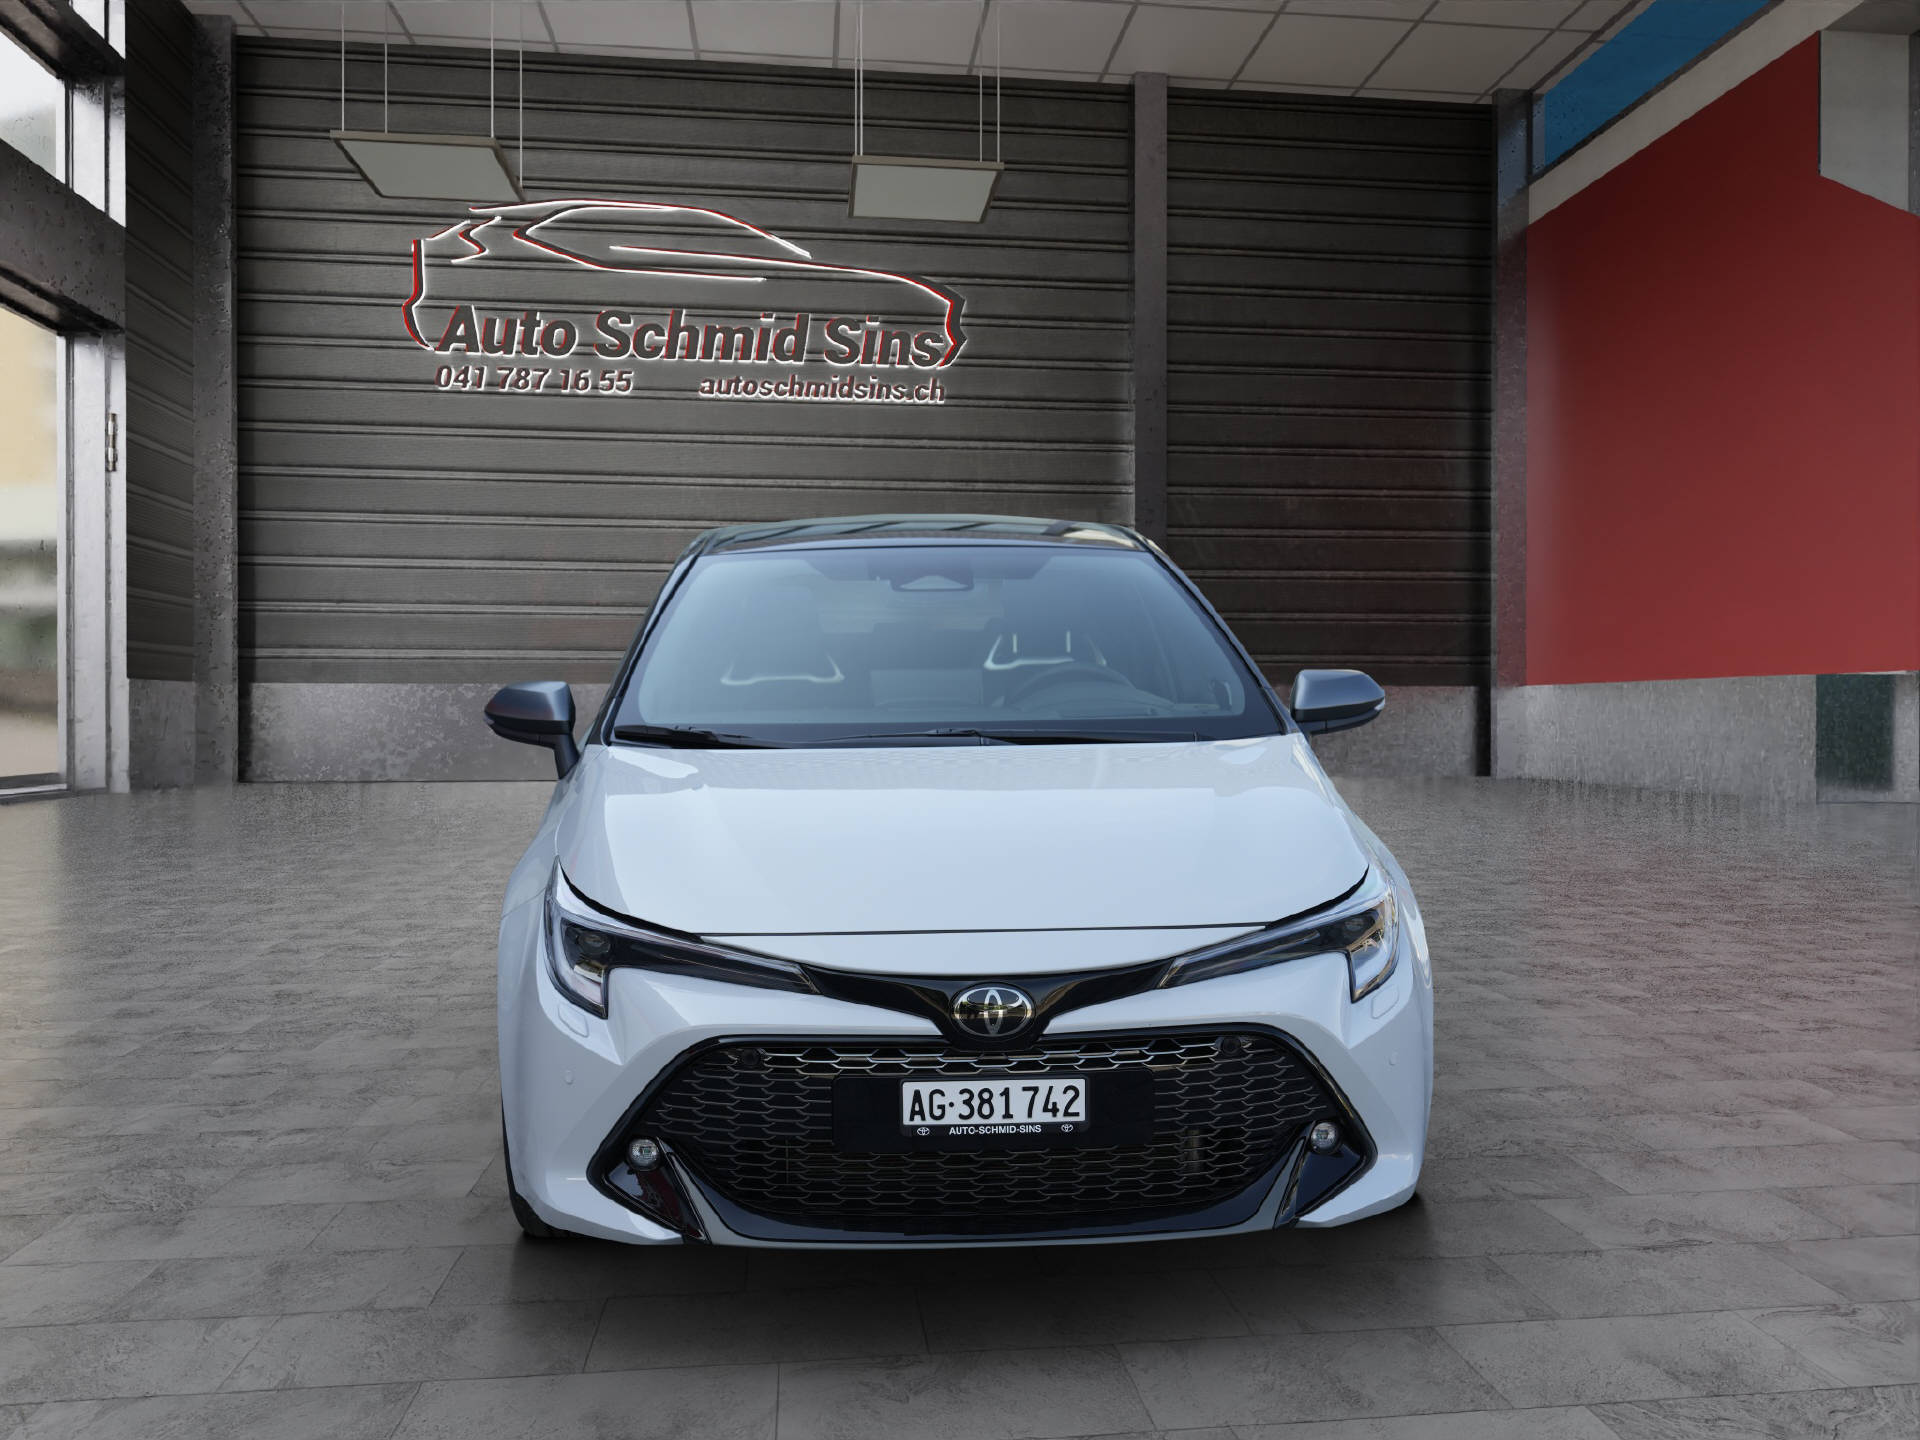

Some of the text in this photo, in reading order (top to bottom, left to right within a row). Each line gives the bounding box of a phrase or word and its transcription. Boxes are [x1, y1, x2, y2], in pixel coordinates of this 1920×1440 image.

[434, 304, 946, 370] Auto Schmid Sins
[435, 365, 634, 394] 041 787 16 55
[699, 374, 946, 404] autoschmidsins.ch
[949, 1124, 1042, 1136] AUTO-SCHMID-SINS
